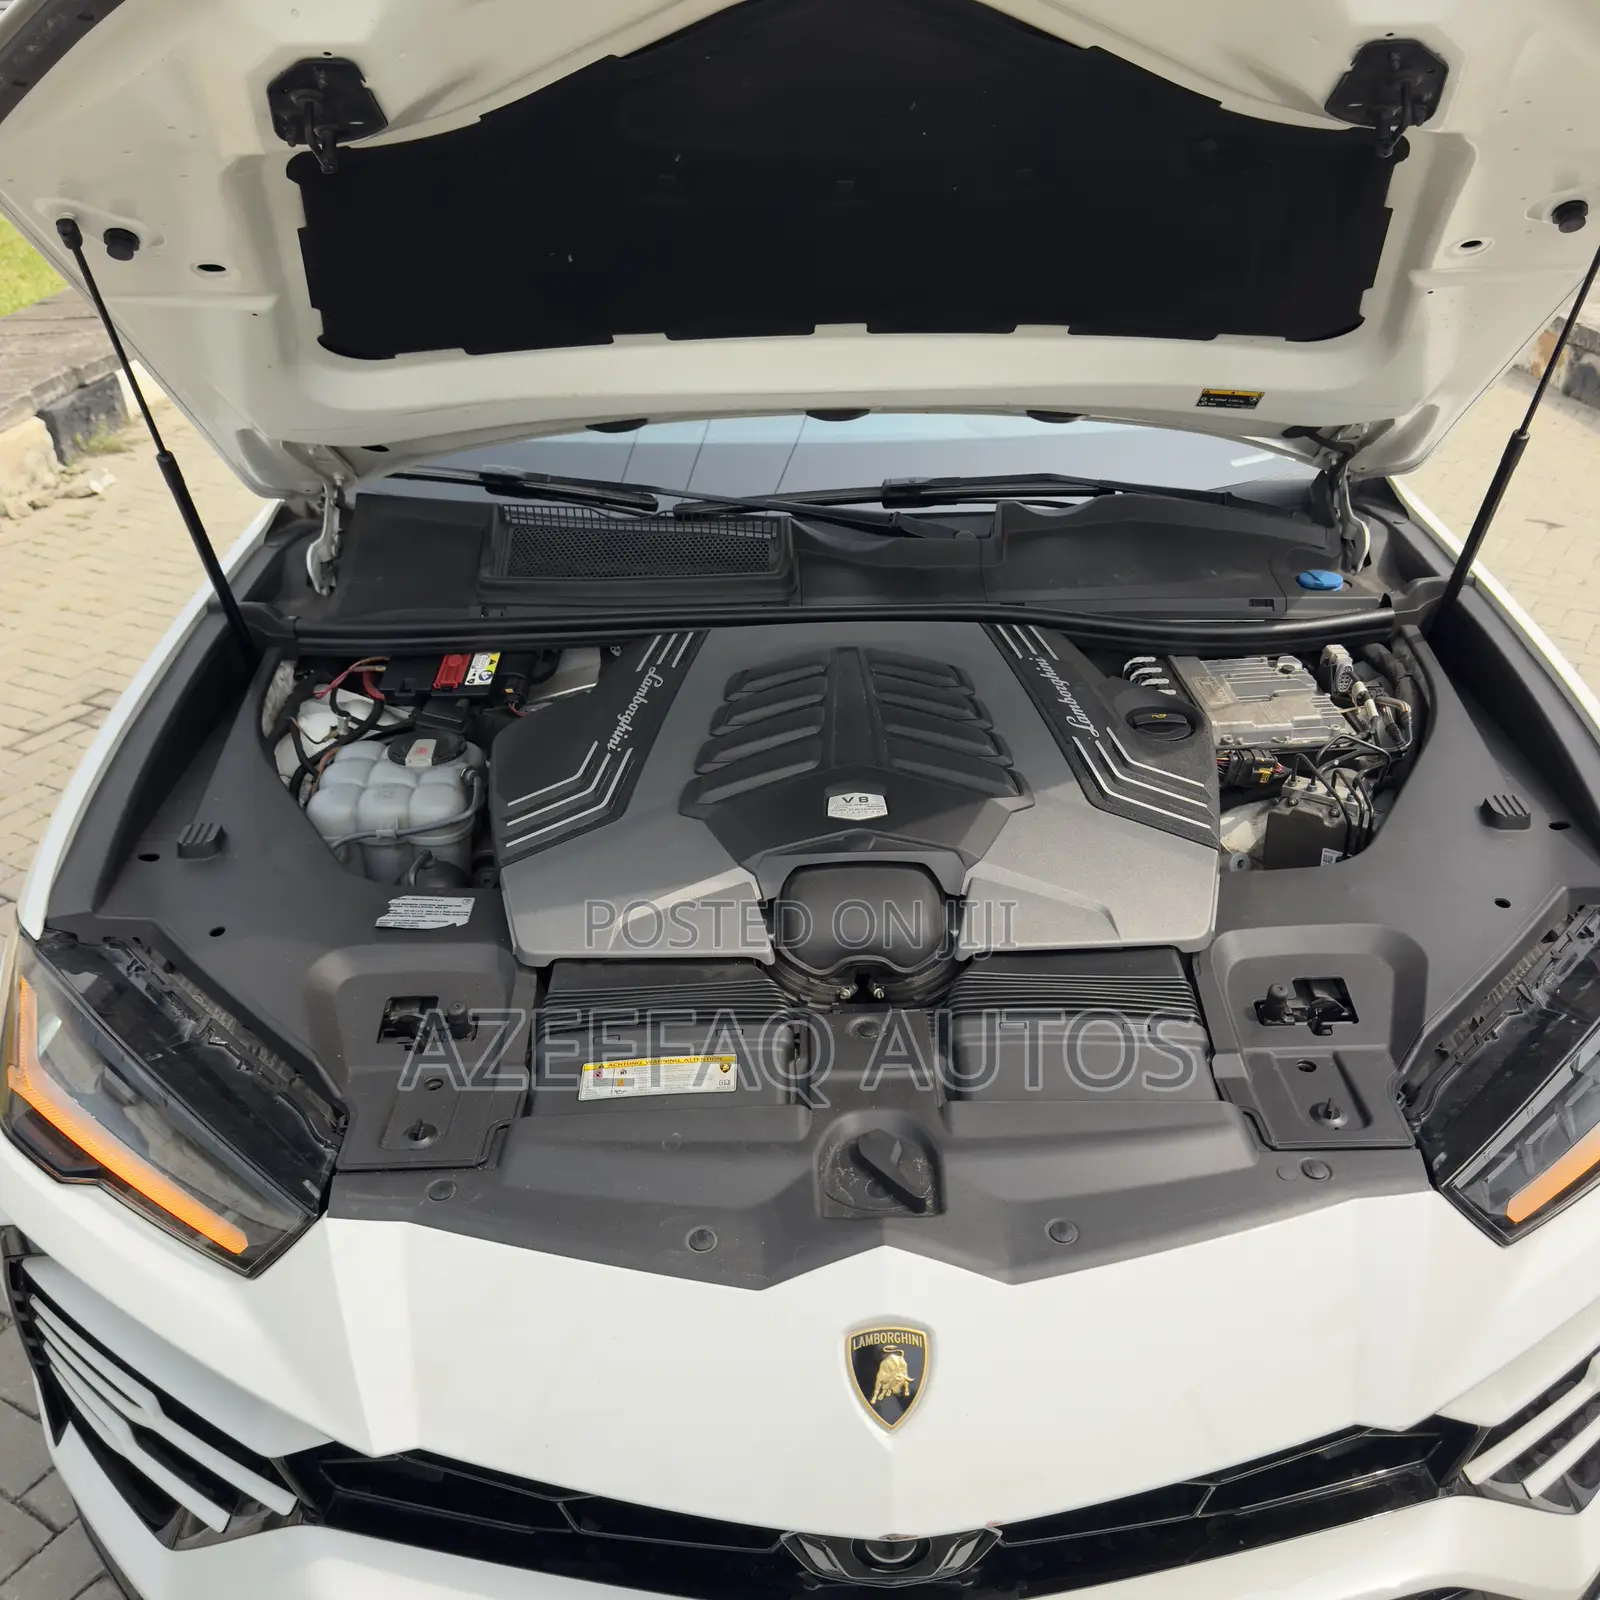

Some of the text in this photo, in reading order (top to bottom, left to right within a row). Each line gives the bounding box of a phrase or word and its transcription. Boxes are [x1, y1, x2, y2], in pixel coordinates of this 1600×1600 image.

[607, 666, 664, 752] Lamborghini
[1028, 655, 1100, 738] Lamborghini
[853, 1332, 923, 1351] LAMBORGHINI
